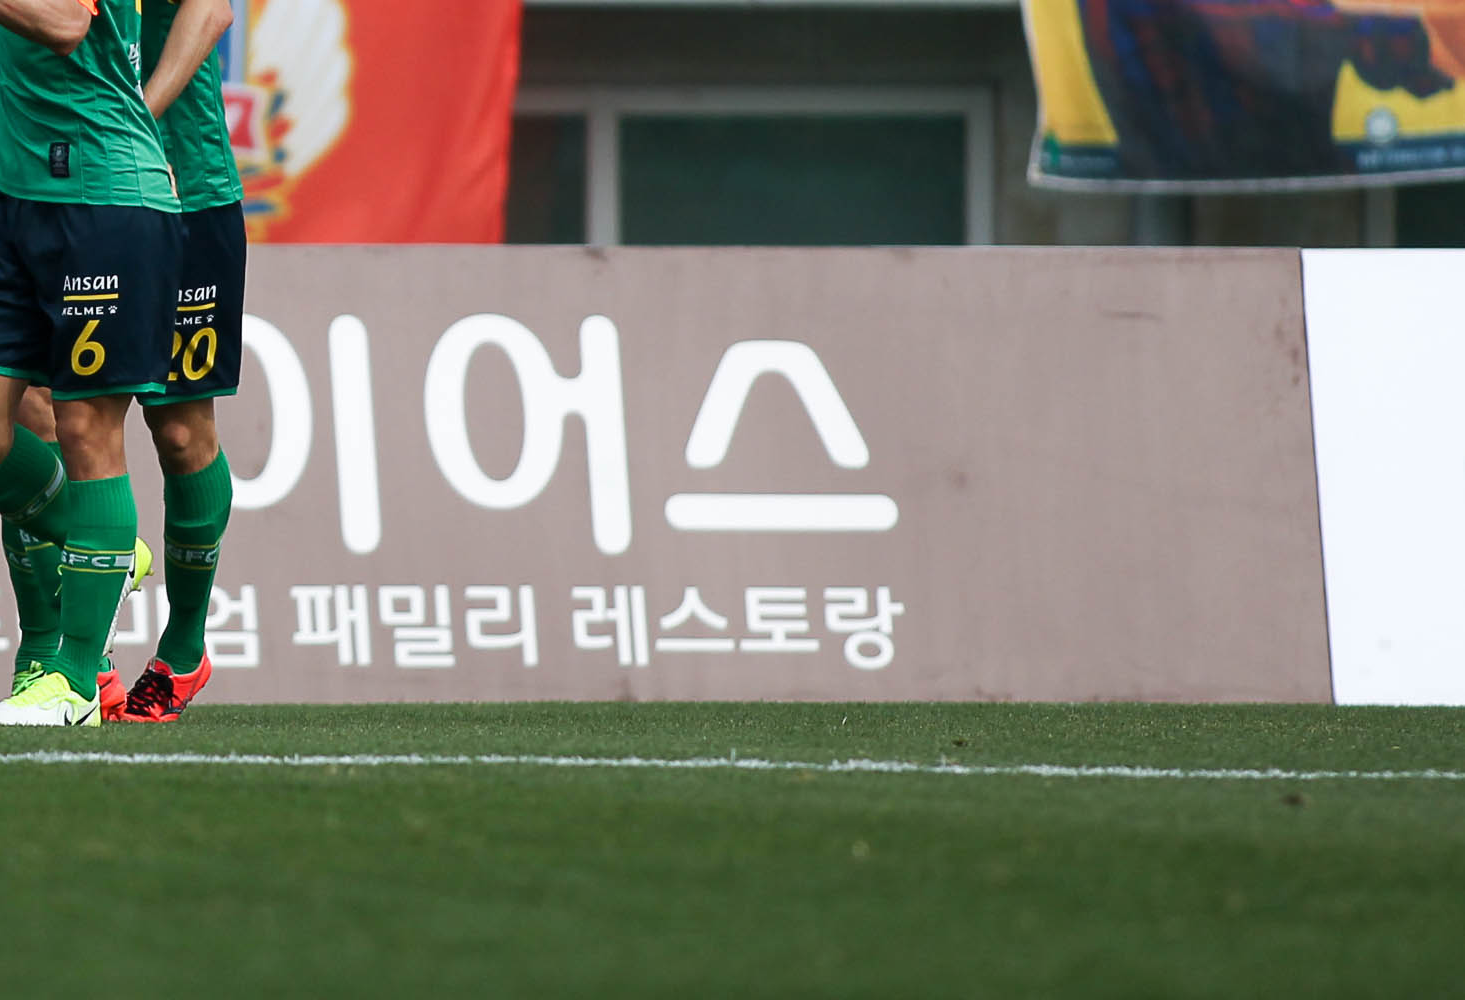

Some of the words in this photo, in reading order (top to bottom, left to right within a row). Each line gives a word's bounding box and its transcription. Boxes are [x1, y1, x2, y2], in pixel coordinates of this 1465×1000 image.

[62, 274, 119, 292] Ansan
[70, 318, 106, 377] 6
[291, 584, 539, 669] 패밀리
[571, 584, 906, 671] 레스토랑
